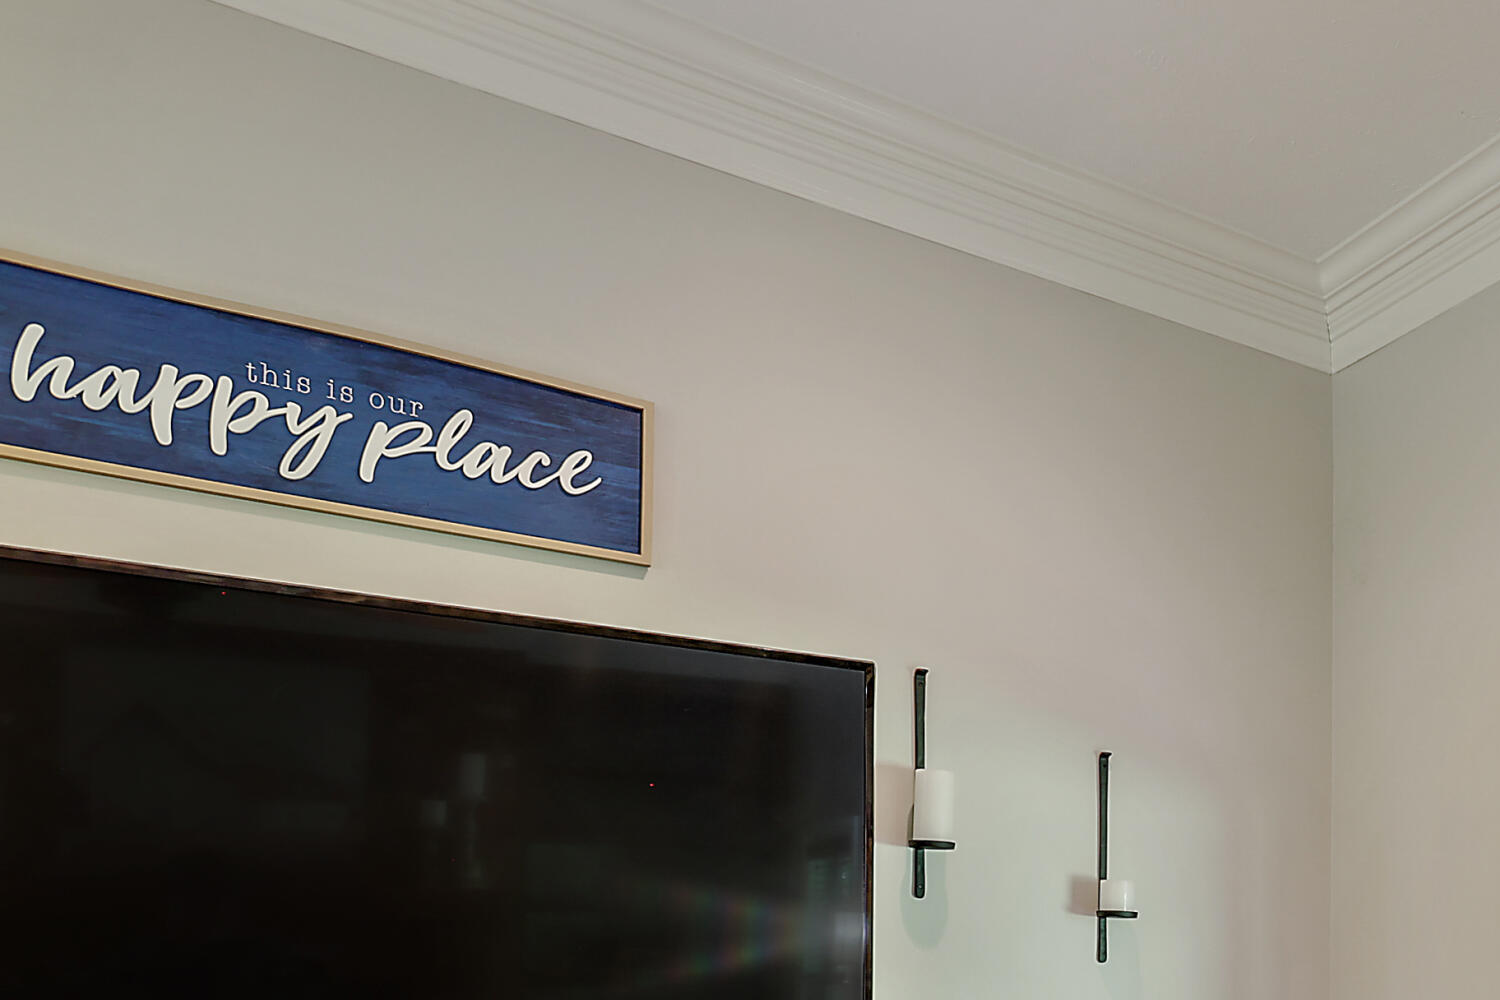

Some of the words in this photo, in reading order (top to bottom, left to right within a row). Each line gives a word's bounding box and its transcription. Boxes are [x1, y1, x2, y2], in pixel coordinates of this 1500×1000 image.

[11, 323, 353, 480] happy
[358, 409, 602, 496] place
[245, 361, 311, 395] this
[326, 379, 355, 402] is
[369, 394, 424, 418] our
